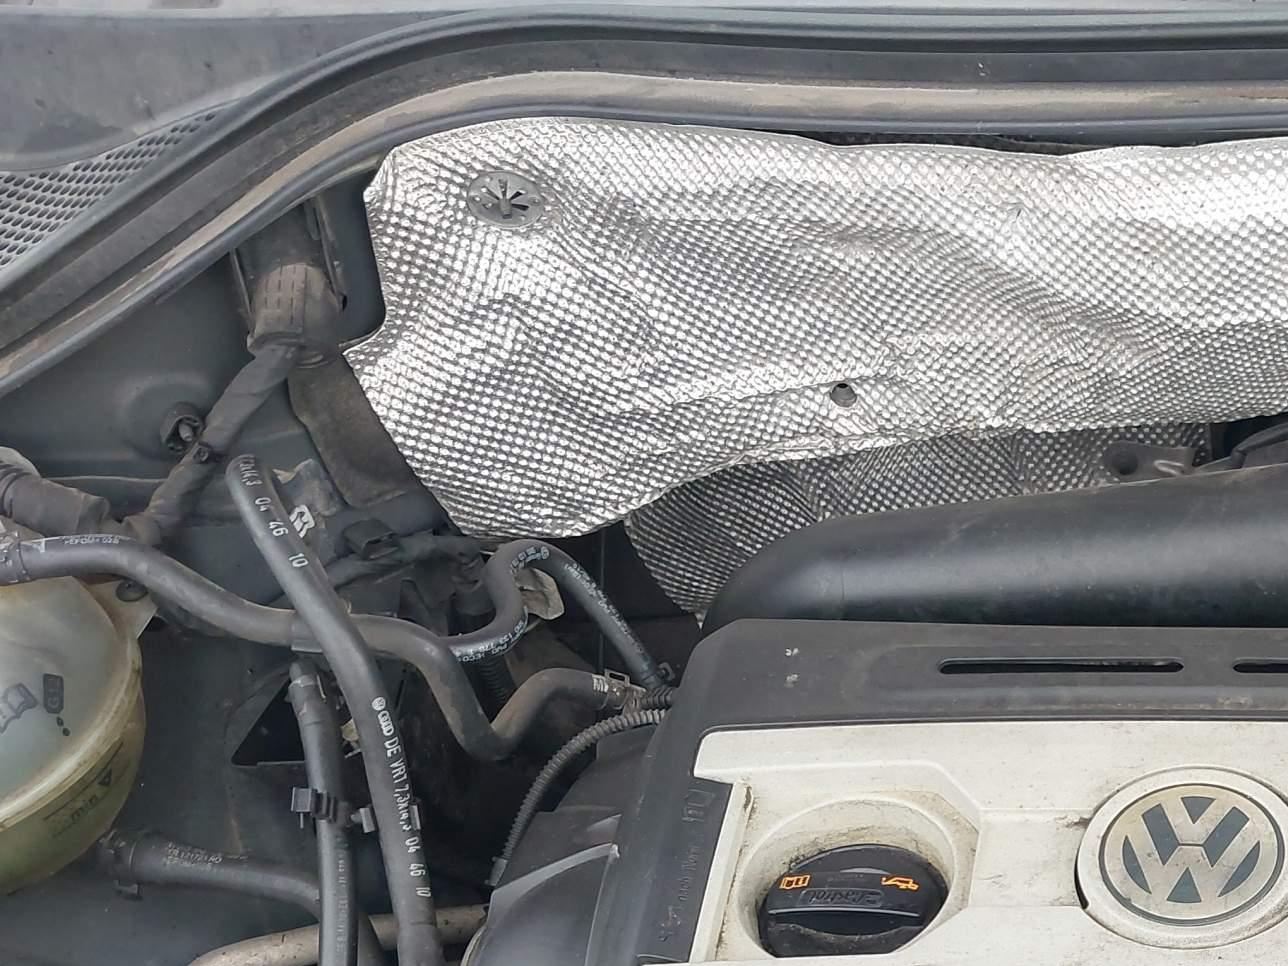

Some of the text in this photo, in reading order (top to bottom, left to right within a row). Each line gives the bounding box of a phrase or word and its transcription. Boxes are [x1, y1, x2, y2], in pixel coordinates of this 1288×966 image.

[268, 520, 289, 538] 46
[288, 552, 310, 569] 10
[383, 738, 402, 758] DE
[405, 836, 422, 853] 04
[408, 862, 427, 878] 46
[415, 886, 432, 899] 10
